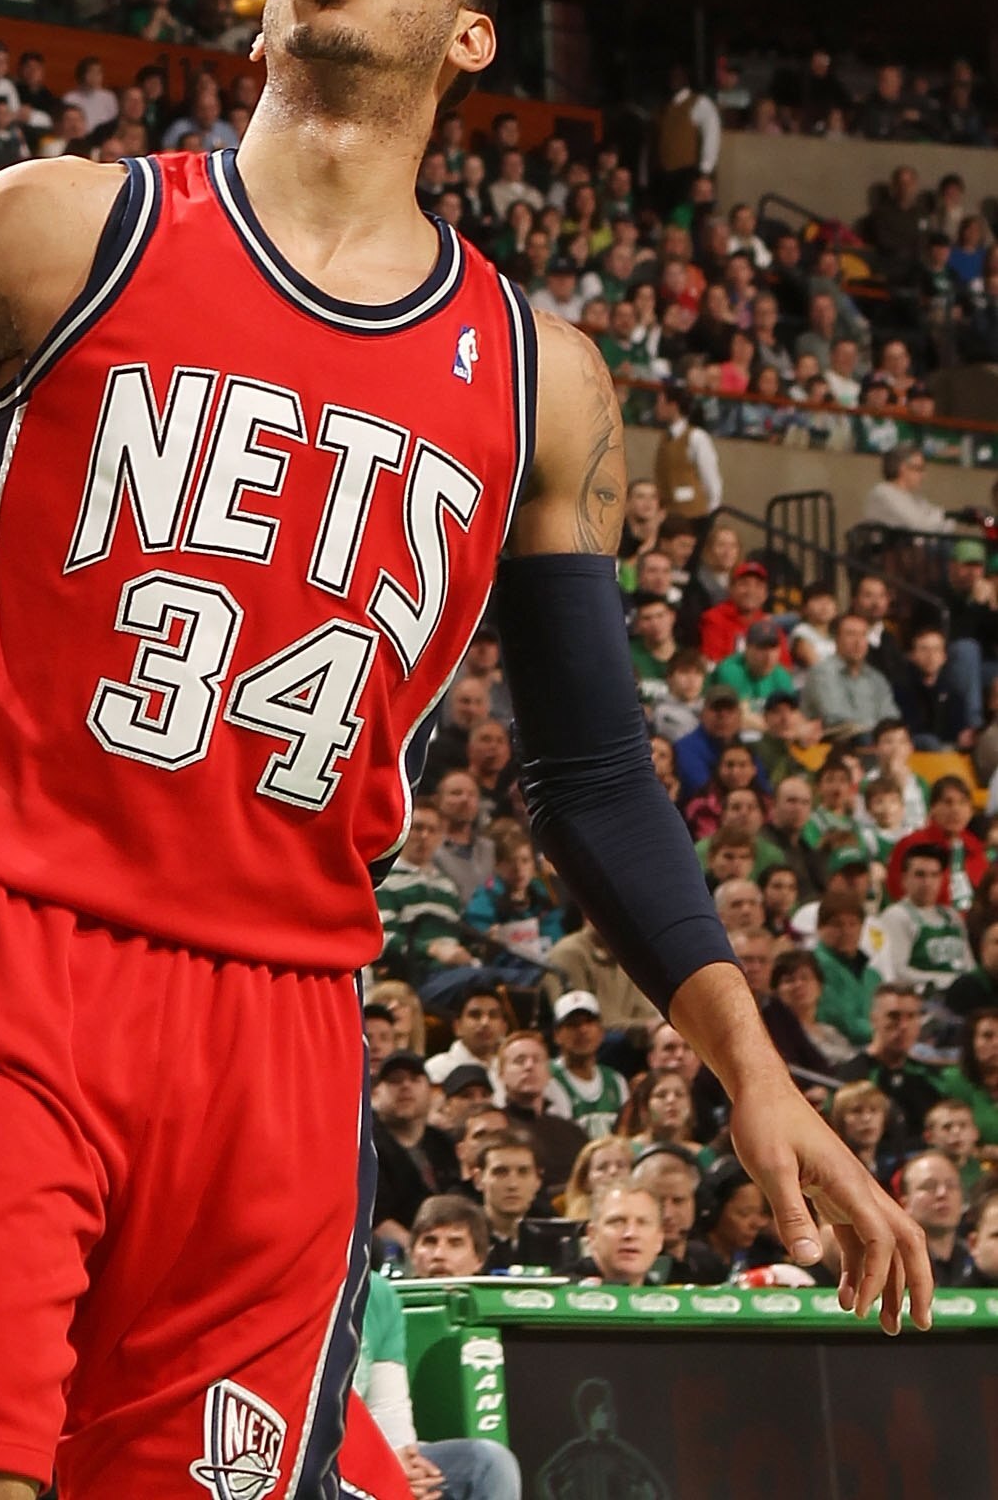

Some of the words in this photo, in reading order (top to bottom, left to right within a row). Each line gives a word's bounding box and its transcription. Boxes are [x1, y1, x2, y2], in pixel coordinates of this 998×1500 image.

[62, 363, 483, 680] NETS
[86, 569, 380, 812] 34
[224, 1396, 283, 1472] NETS
